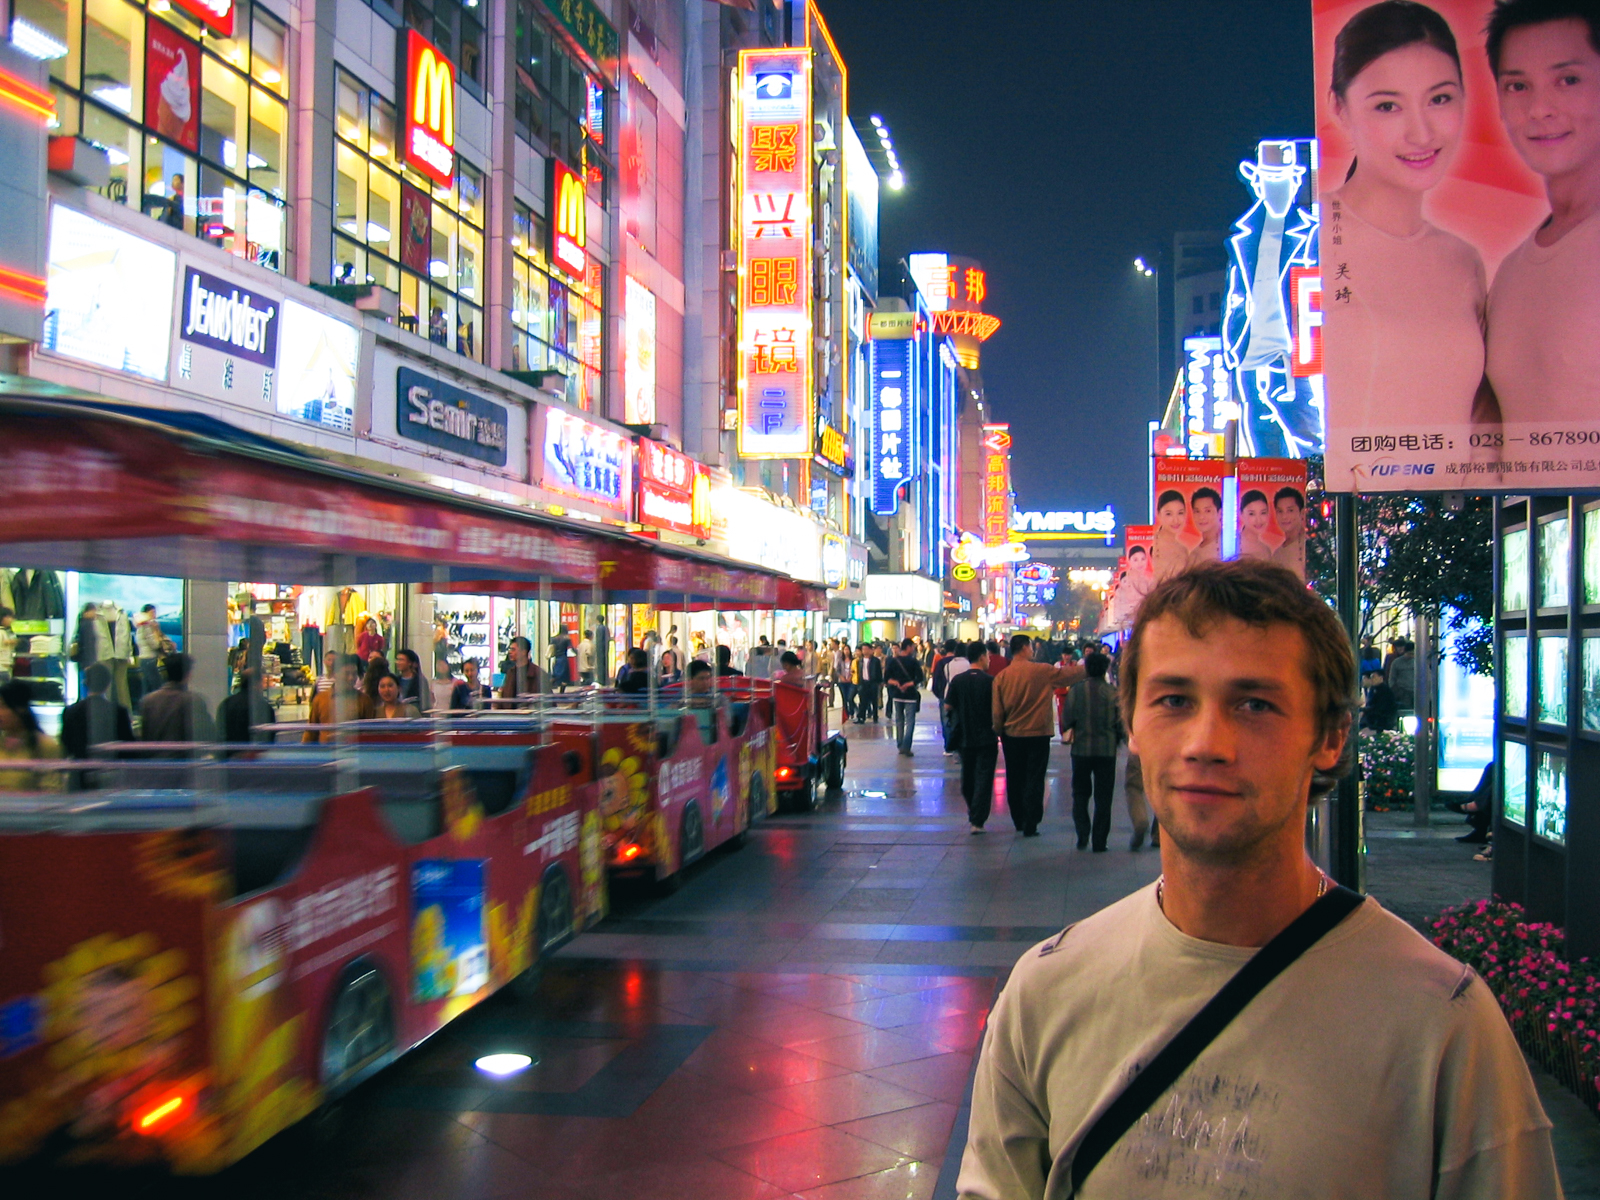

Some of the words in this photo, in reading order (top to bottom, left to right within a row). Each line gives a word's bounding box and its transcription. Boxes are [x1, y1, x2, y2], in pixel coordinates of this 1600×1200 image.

[750, 123, 798, 374] 聚兴眼镜
[926, 265, 987, 304] 高邦
[408, 385, 477, 440] Semir
[1445, 459, 1600, 475] 成都裕鹏服饰有限公司总
[1012, 511, 1116, 531] YMPUS
